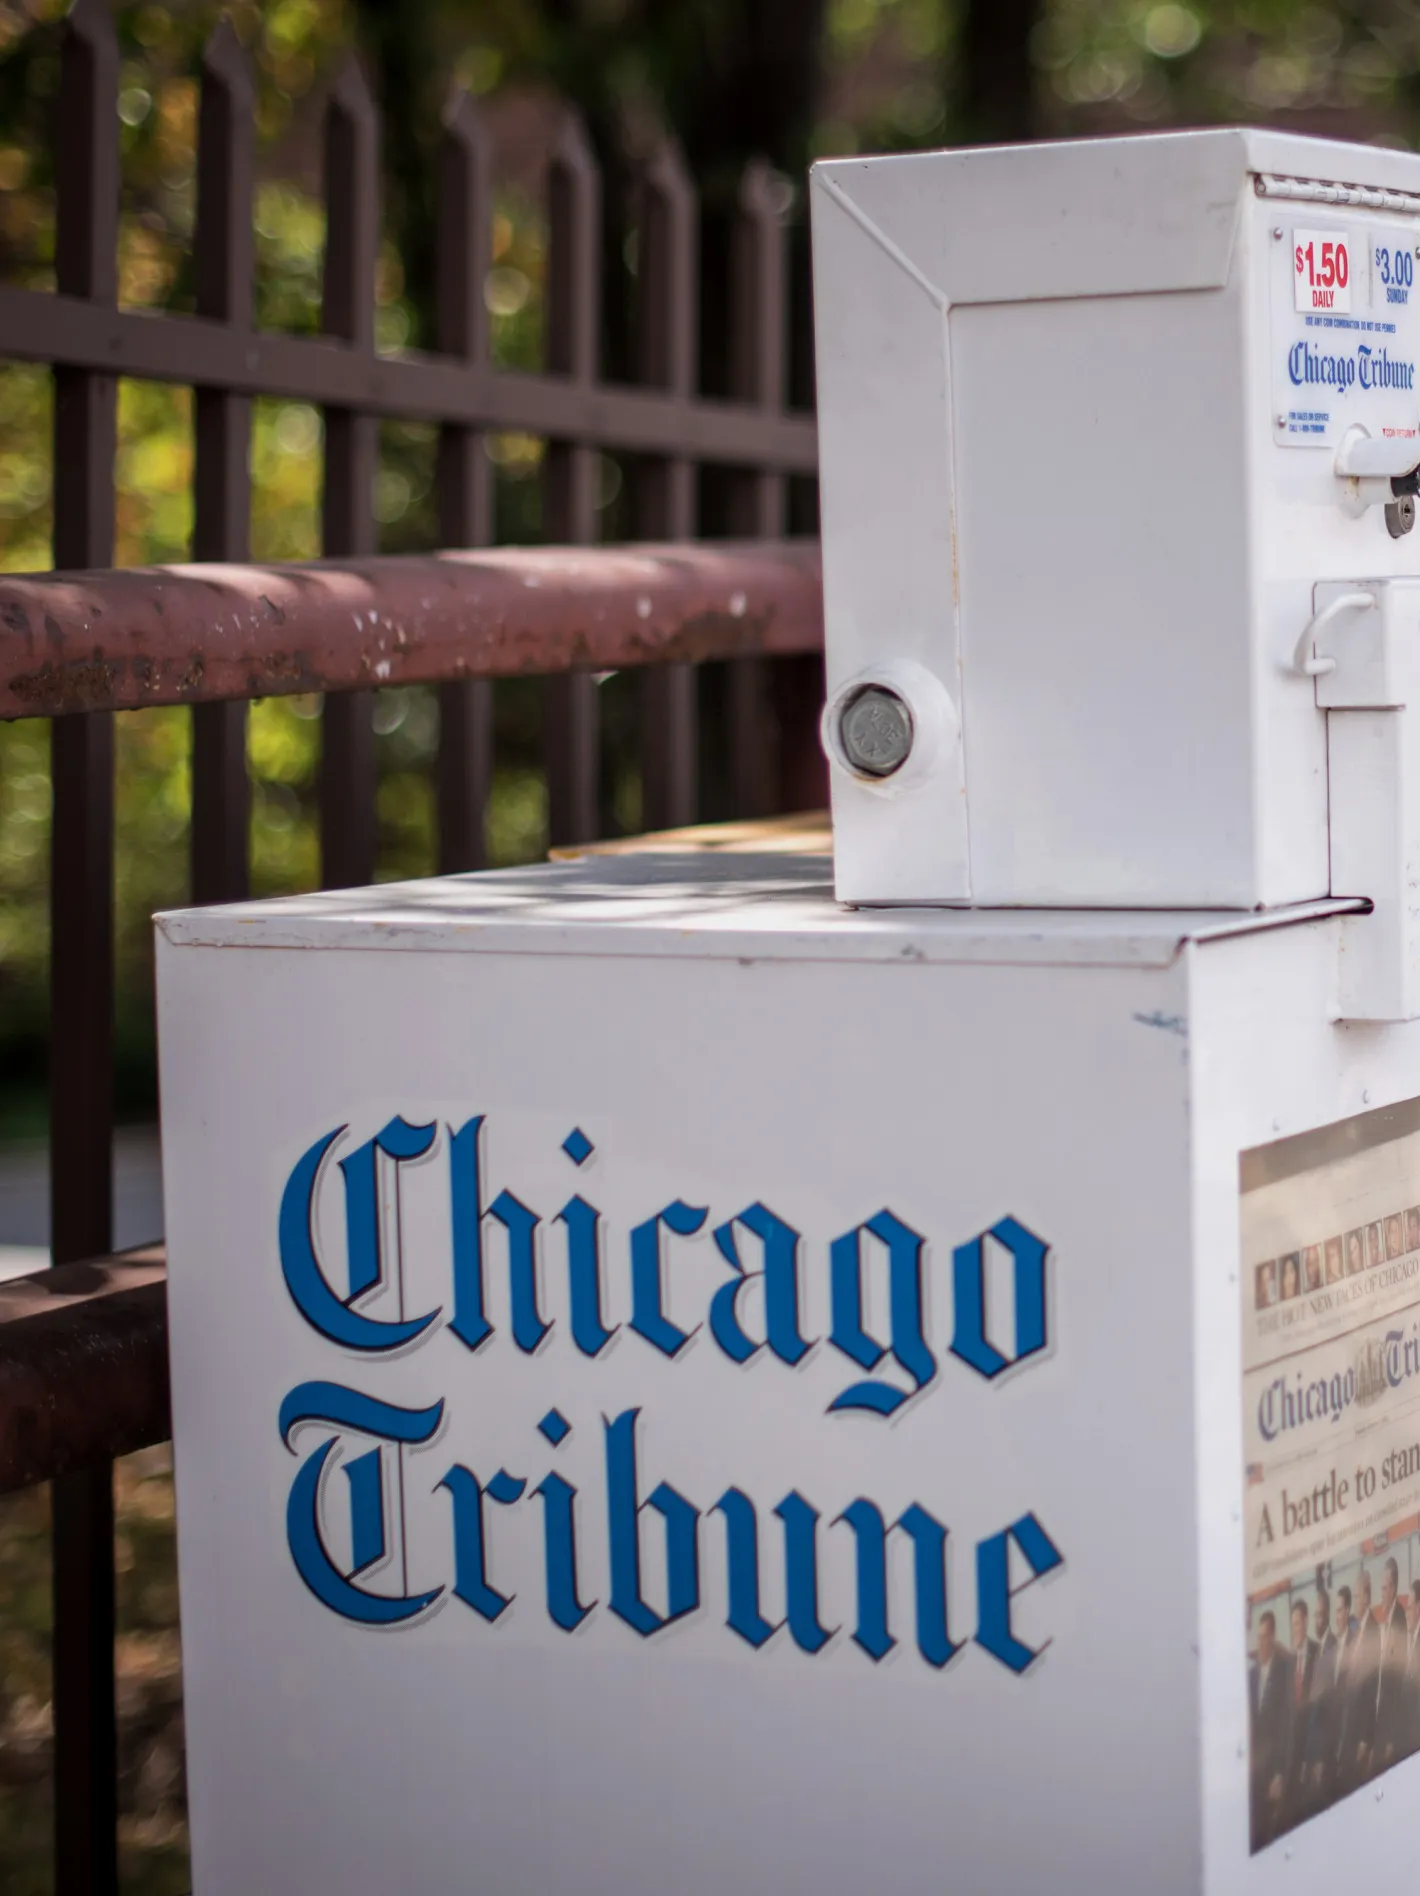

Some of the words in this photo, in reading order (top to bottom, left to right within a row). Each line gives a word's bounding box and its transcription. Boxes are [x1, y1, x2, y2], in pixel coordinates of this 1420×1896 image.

[1295, 242, 1348, 288] $1.50
[1376, 248, 1412, 287] $3.00
[1312, 290, 1334, 308] DAILY
[1386, 288, 1409, 305] SUNDAY
[1323, 317, 1333, 328] COIN
[1334, 318, 1360, 330] COMBINATION
[1288, 341, 1355, 393] Chicago
[1357, 345, 1415, 389] Tribune
[278, 1114, 1054, 1418] Chicago
[1379, 1257, 1419, 1289] CHICAGO
[1257, 1366, 1355, 1442] Chicago
[278, 1380, 1066, 1676] Tribune
[1256, 1501, 1275, 1548] A
[1281, 1468, 1349, 1537] battle
[1354, 1466, 1376, 1503] to
